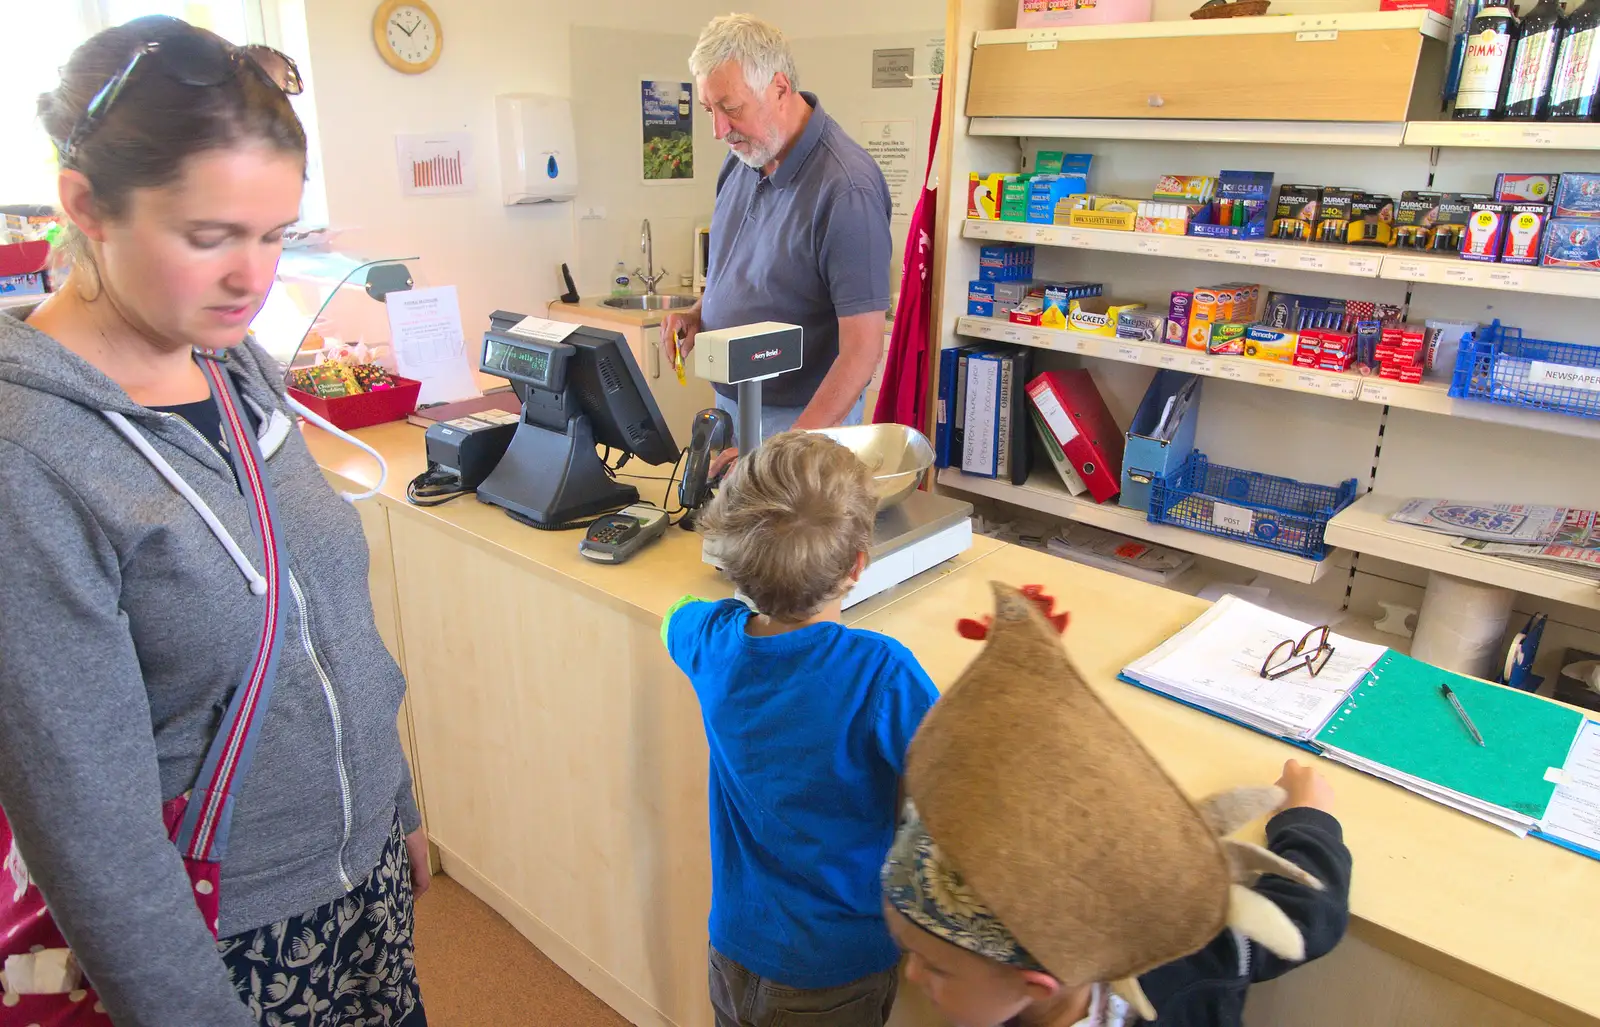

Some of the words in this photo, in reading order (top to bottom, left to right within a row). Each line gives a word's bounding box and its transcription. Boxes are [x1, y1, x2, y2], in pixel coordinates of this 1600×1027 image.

[1468, 42, 1503, 57] PIMM'S
[1237, 184, 1264, 192] CLEAR
[1547, 175, 1558, 202] MAXIM
[1279, 195, 1309, 203] DURACELL
[1323, 196, 1351, 204] DURACEL
[1400, 201, 1433, 209] DURACELL
[1440, 204, 1470, 212] DURACEL
[1472, 203, 1502, 211] MAXIM
[1513, 205, 1544, 213] MAXIM
[1207, 226, 1230, 234] CLEAR
[1071, 312, 1106, 325] LOCKETS
[1120, 315, 1155, 329] Strepsils
[1222, 324, 1243, 333] LEMSIP
[1251, 330, 1278, 340] Benadryl
[1430, 328, 1443, 349] SPORTS
[1301, 337, 1319, 346] Rennie
[1323, 341, 1342, 350] Rennie
[765, 348, 778, 357] Berkel
[518, 353, 533, 362] Jelly
[1297, 356, 1314, 365] Rennie
[1427, 348, 1435, 369] DIRECT
[318, 382, 343, 390] Christmas
[982, 366, 995, 413] DOCUMENTS
[969, 386, 978, 423] VILLAGE
[979, 418, 989, 466] OPERATING
[998, 415, 1008, 467] NEWSPAPER
[1223, 516, 1240, 526] POST
